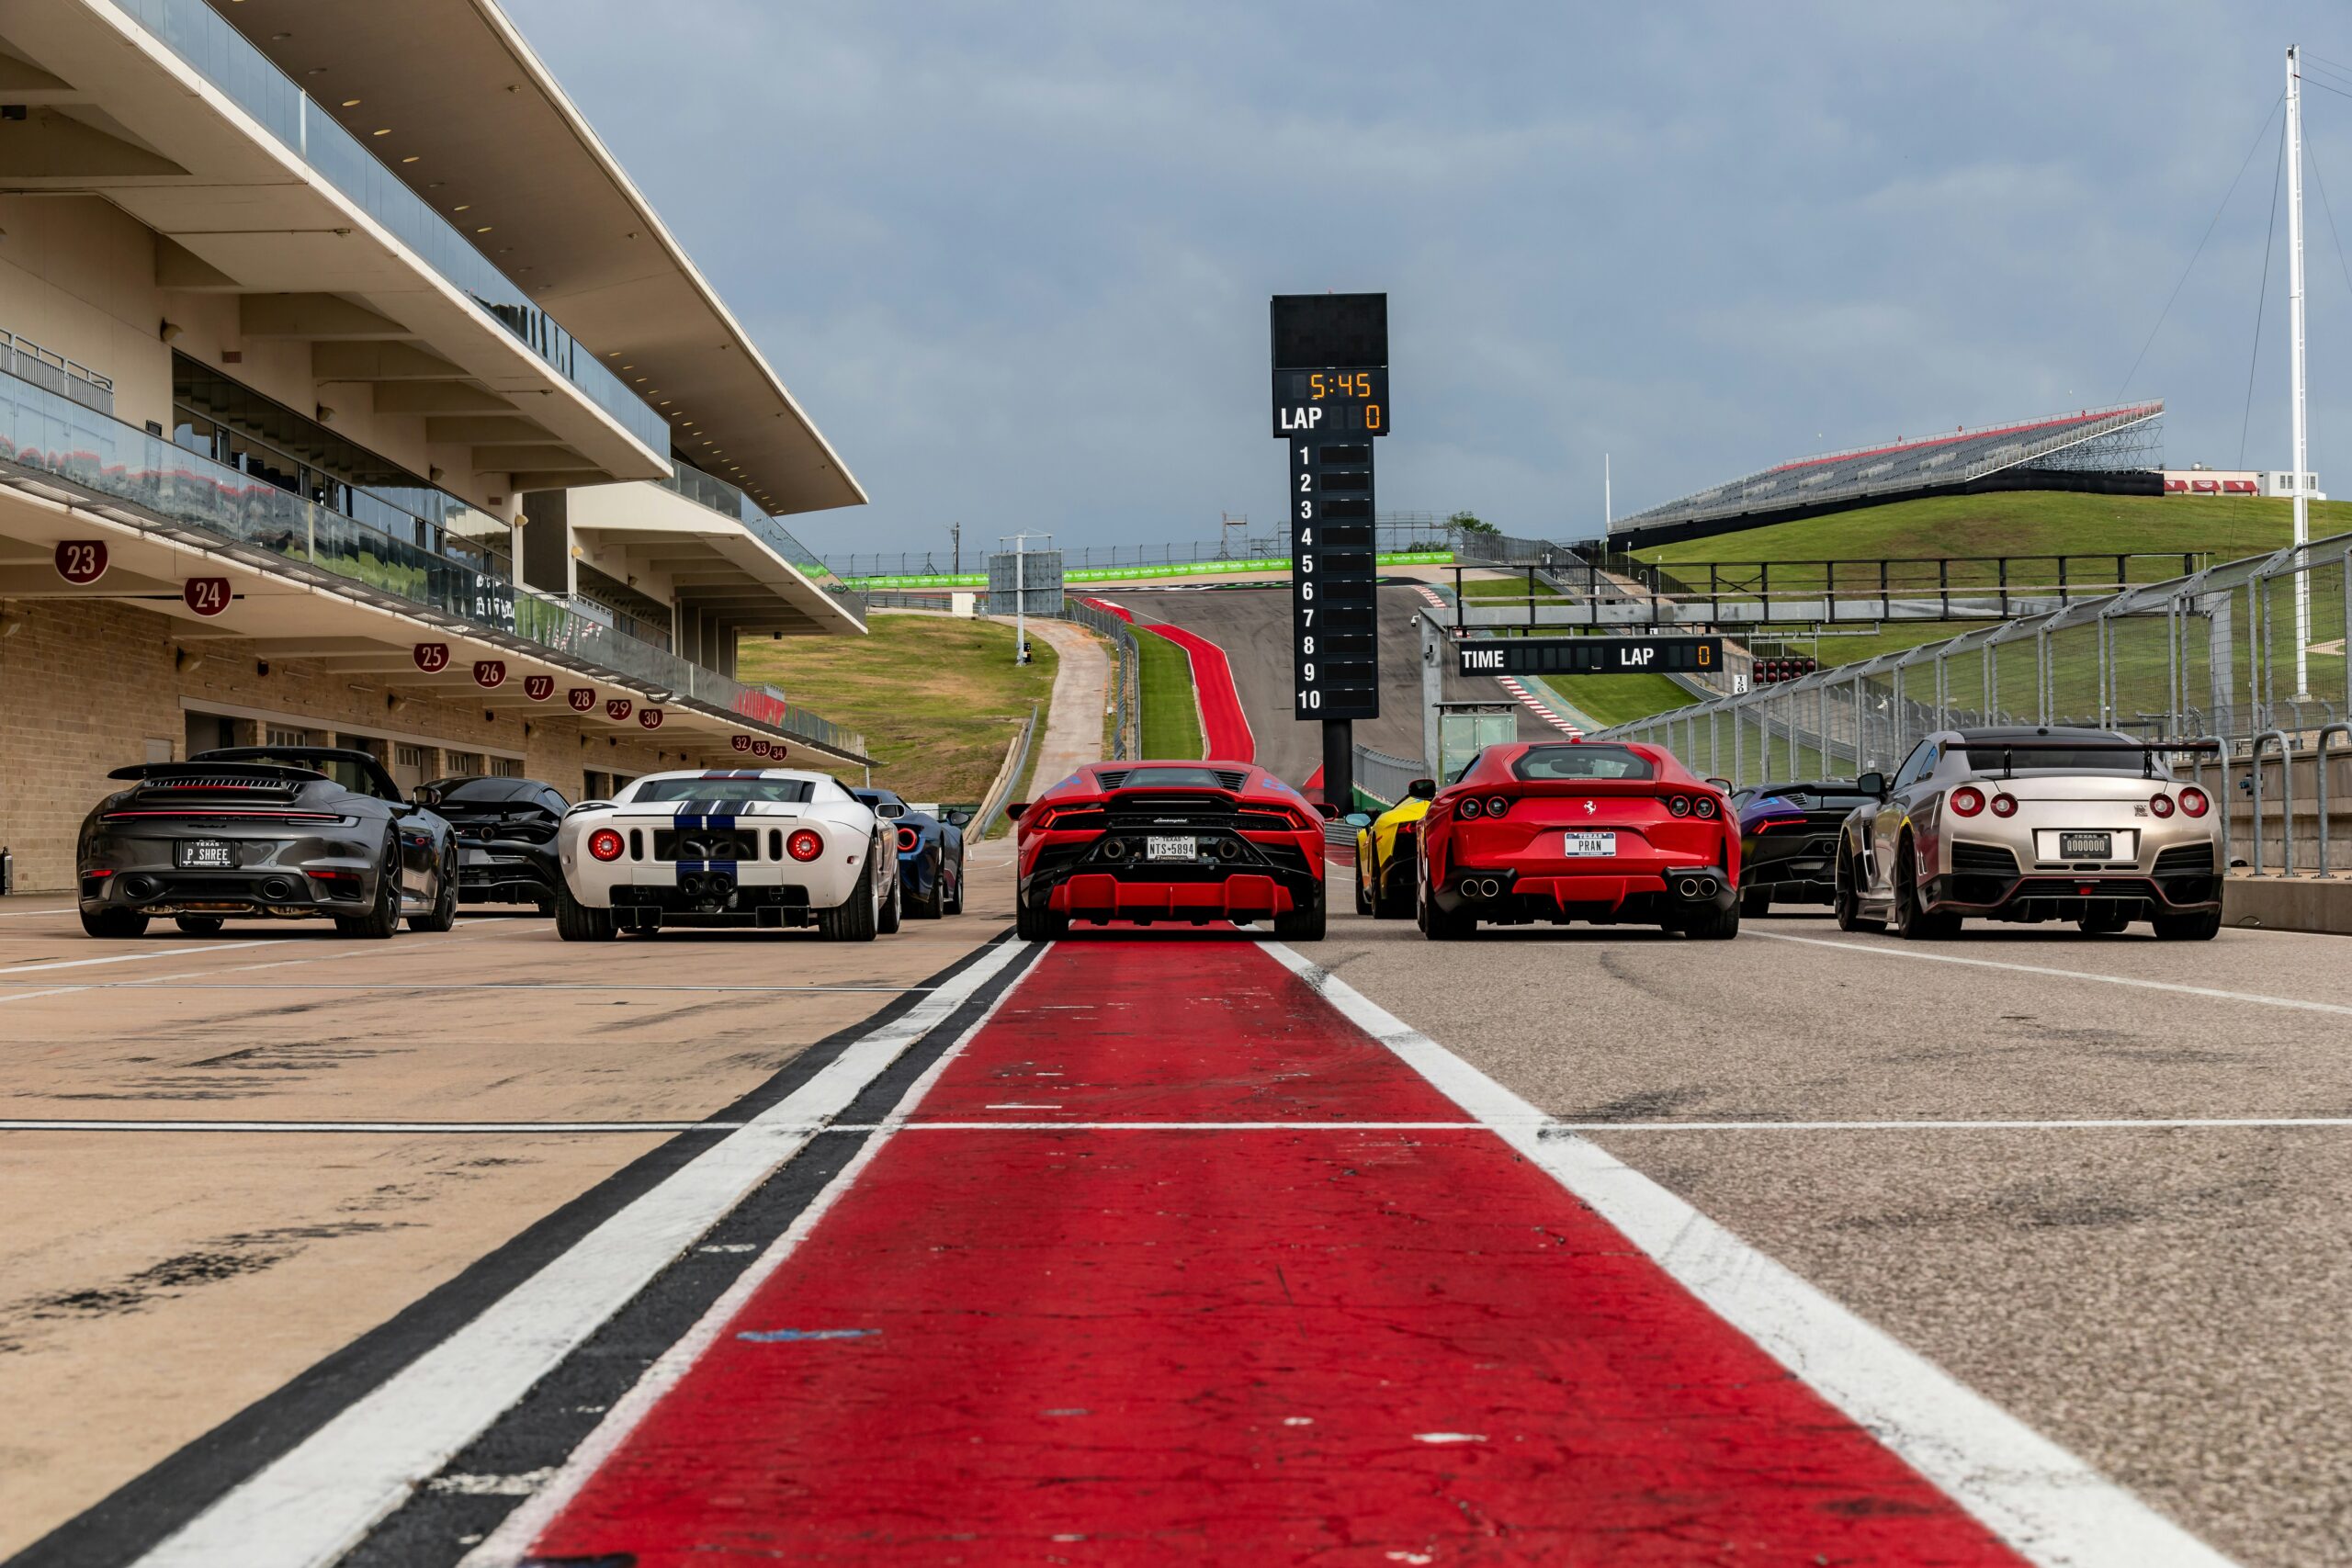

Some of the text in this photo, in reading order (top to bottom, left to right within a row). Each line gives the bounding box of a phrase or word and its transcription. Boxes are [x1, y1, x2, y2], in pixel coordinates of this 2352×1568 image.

[1310, 373, 1371, 400] 5:45
[1281, 404, 1380, 430] LAP 0
[1300, 447, 1308, 465] 1
[1300, 474, 1312, 491] 2
[1301, 501, 1312, 519] 3
[1301, 528, 1312, 546] 4
[66, 546, 96, 573] 23
[1302, 555, 1313, 573] 5
[195, 582, 221, 608] 24
[1302, 581, 1314, 600] 6
[1303, 609, 1314, 627] 7
[1304, 636, 1315, 654] 8
[422, 647, 443, 667] 25
[1461, 646, 1711, 669] TIME LAP 0
[481, 665, 499, 682] 26
[1304, 663, 1315, 682] 9
[531, 679, 548, 696] 27
[1736, 676, 1745, 693] 150
[574, 691, 590, 707] 28
[609, 700, 629, 716] 29
[1298, 691, 1320, 709] 10
[643, 710, 659, 726] 30
[736, 737, 747, 749] 32
[755, 743, 767, 753] 33
[773, 748, 783, 758] 34
[187, 848, 229, 861] P SHREE
[1578, 840, 1601, 852] PRAN
